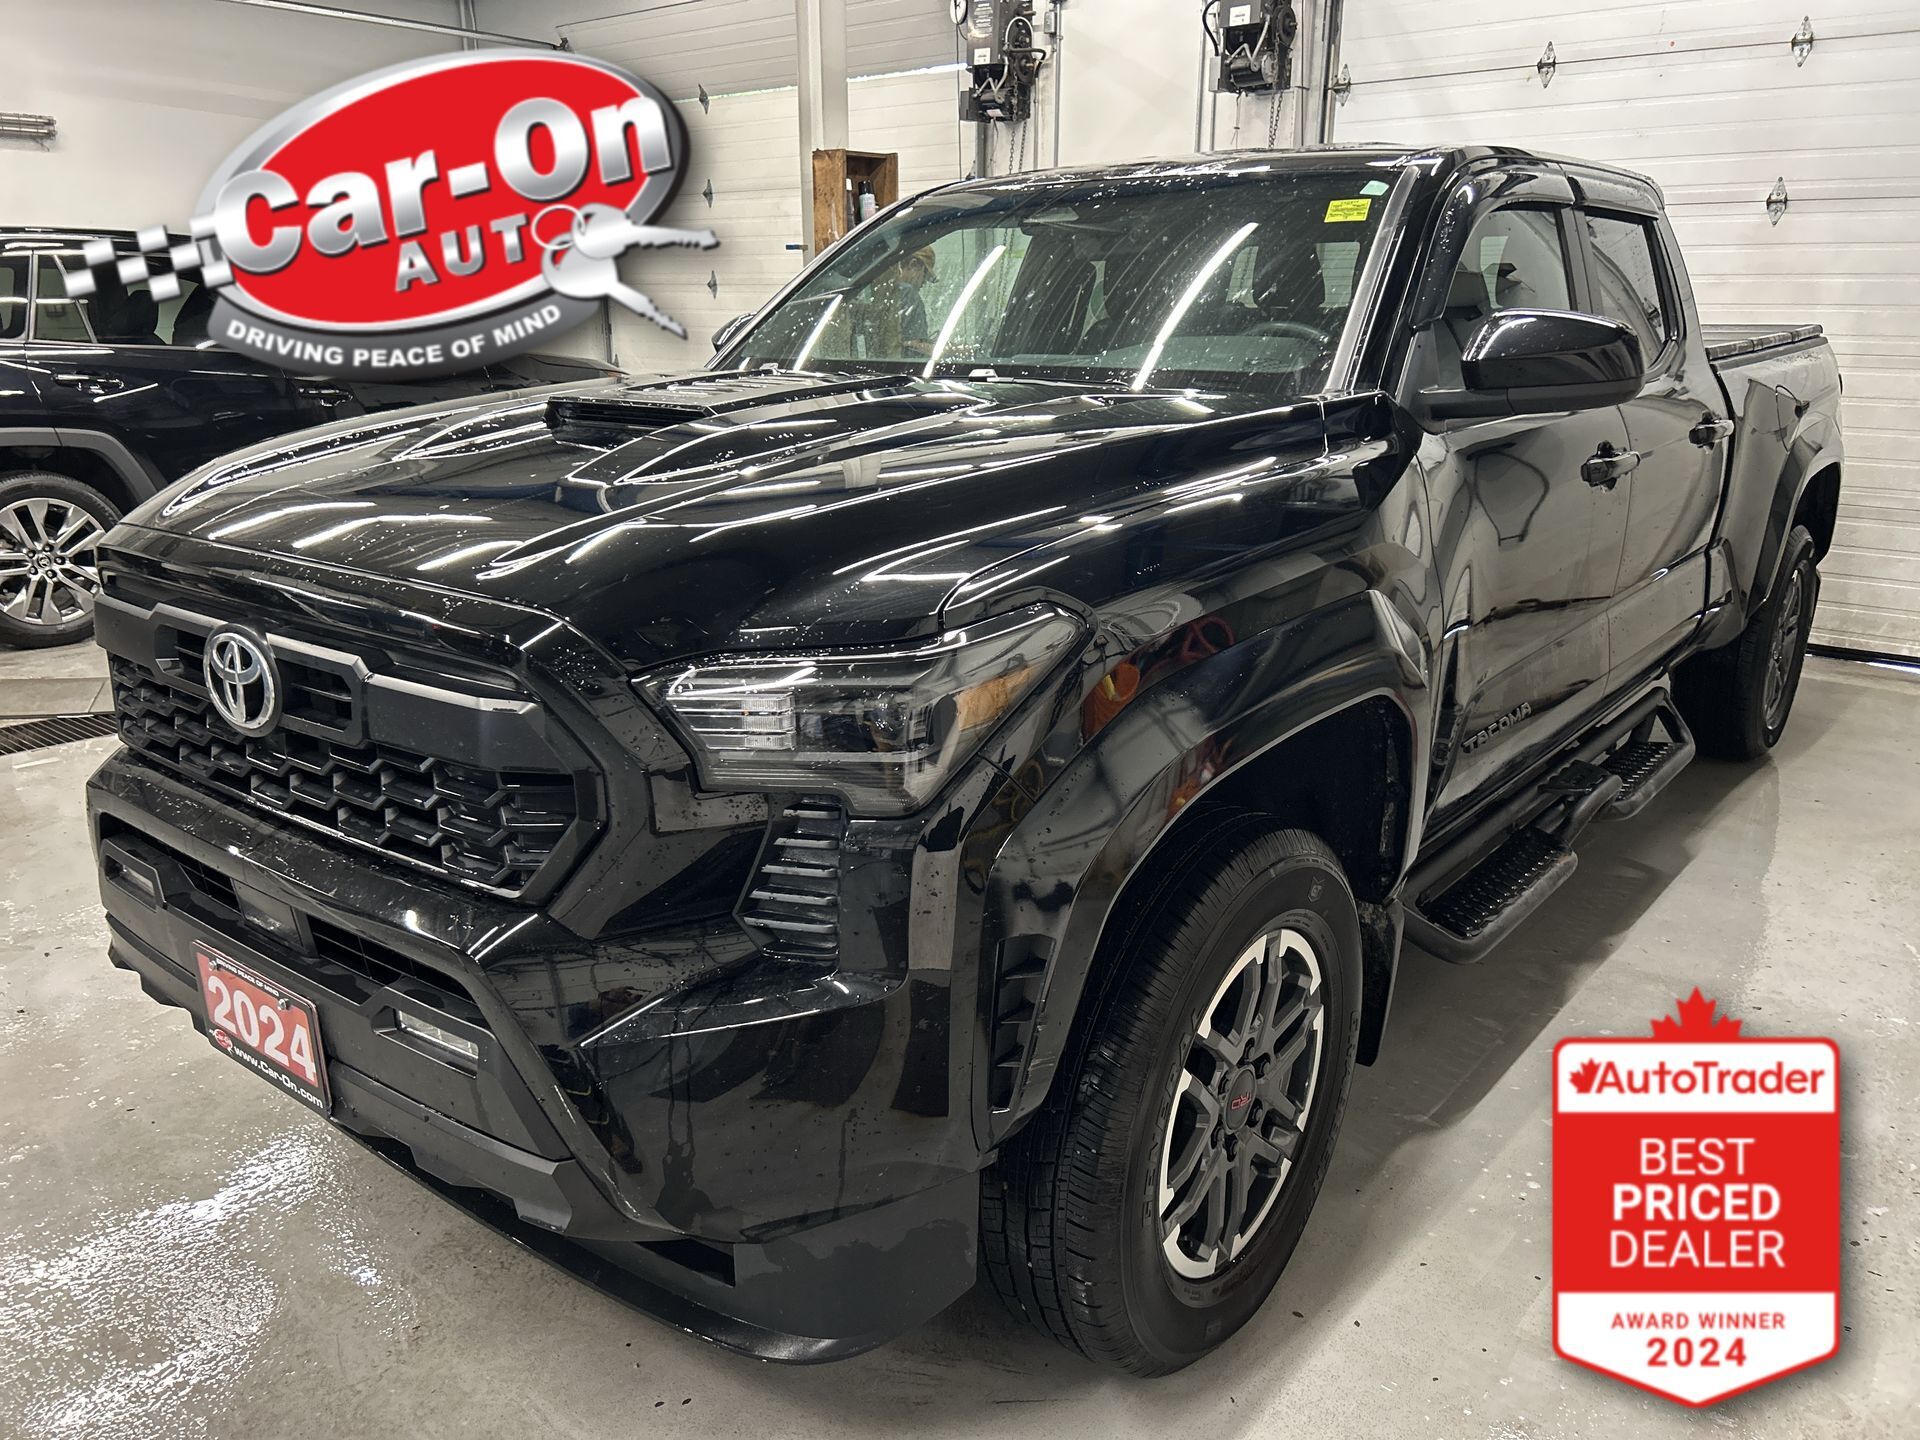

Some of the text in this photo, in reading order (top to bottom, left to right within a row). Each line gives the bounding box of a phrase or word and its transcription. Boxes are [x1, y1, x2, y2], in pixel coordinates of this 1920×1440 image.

[1462, 702, 1532, 753] TACOMA
[207, 975, 317, 1083] 2024
[233, 1045, 324, 1109] www.Car-On.com
